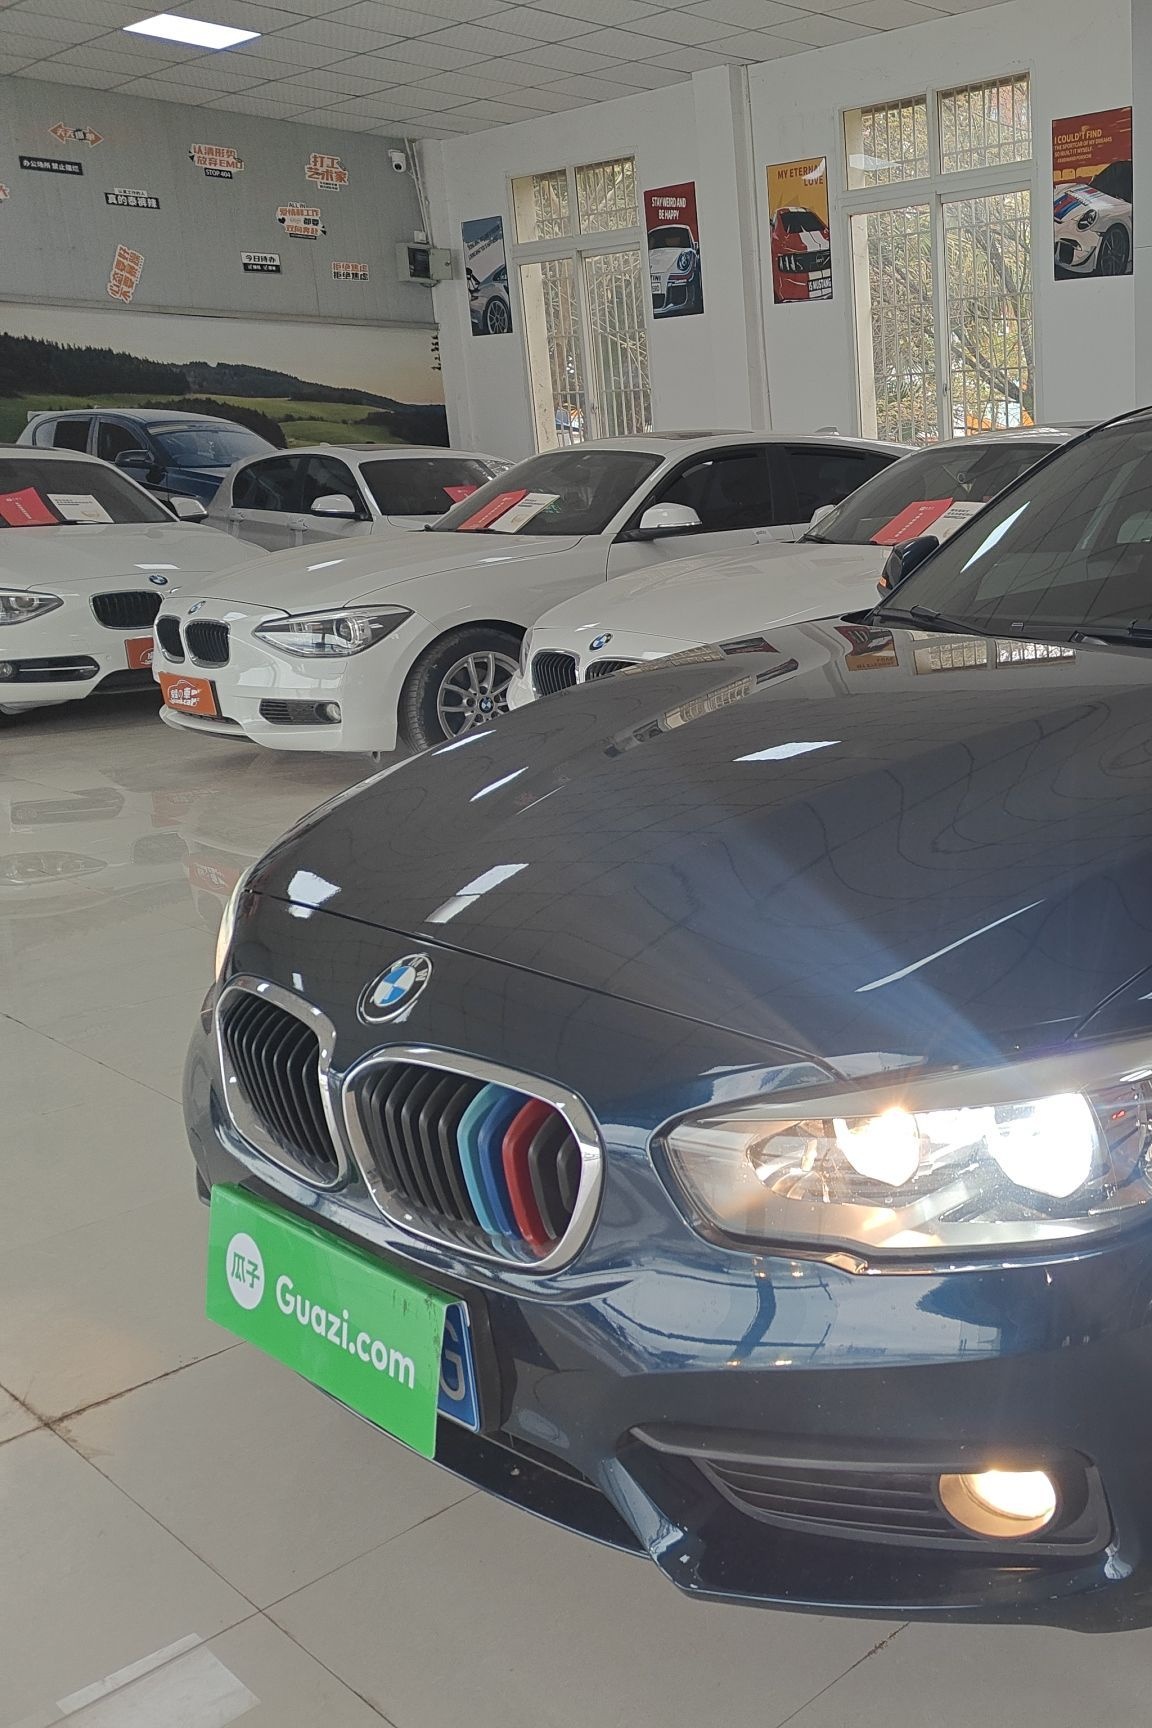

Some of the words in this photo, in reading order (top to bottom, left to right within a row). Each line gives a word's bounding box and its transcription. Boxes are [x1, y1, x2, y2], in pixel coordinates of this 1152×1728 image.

[1086, 129, 1102, 139] FIND
[311, 154, 339, 169] 打工
[205, 169, 220, 177] STOP
[307, 167, 347, 184] 艺术家
[778, 169, 788, 179] MY
[803, 174, 824, 187] LOVE
[651, 197, 662, 207] STAY
[662, 197, 676, 207] WEIRD
[676, 198, 687, 207] AND
[658, 210, 665, 219] BE
[665, 210, 680, 219] HAPPY
[231, 1252, 261, 1289] 瓜子
[276, 1275, 415, 1389] Guazi.com
